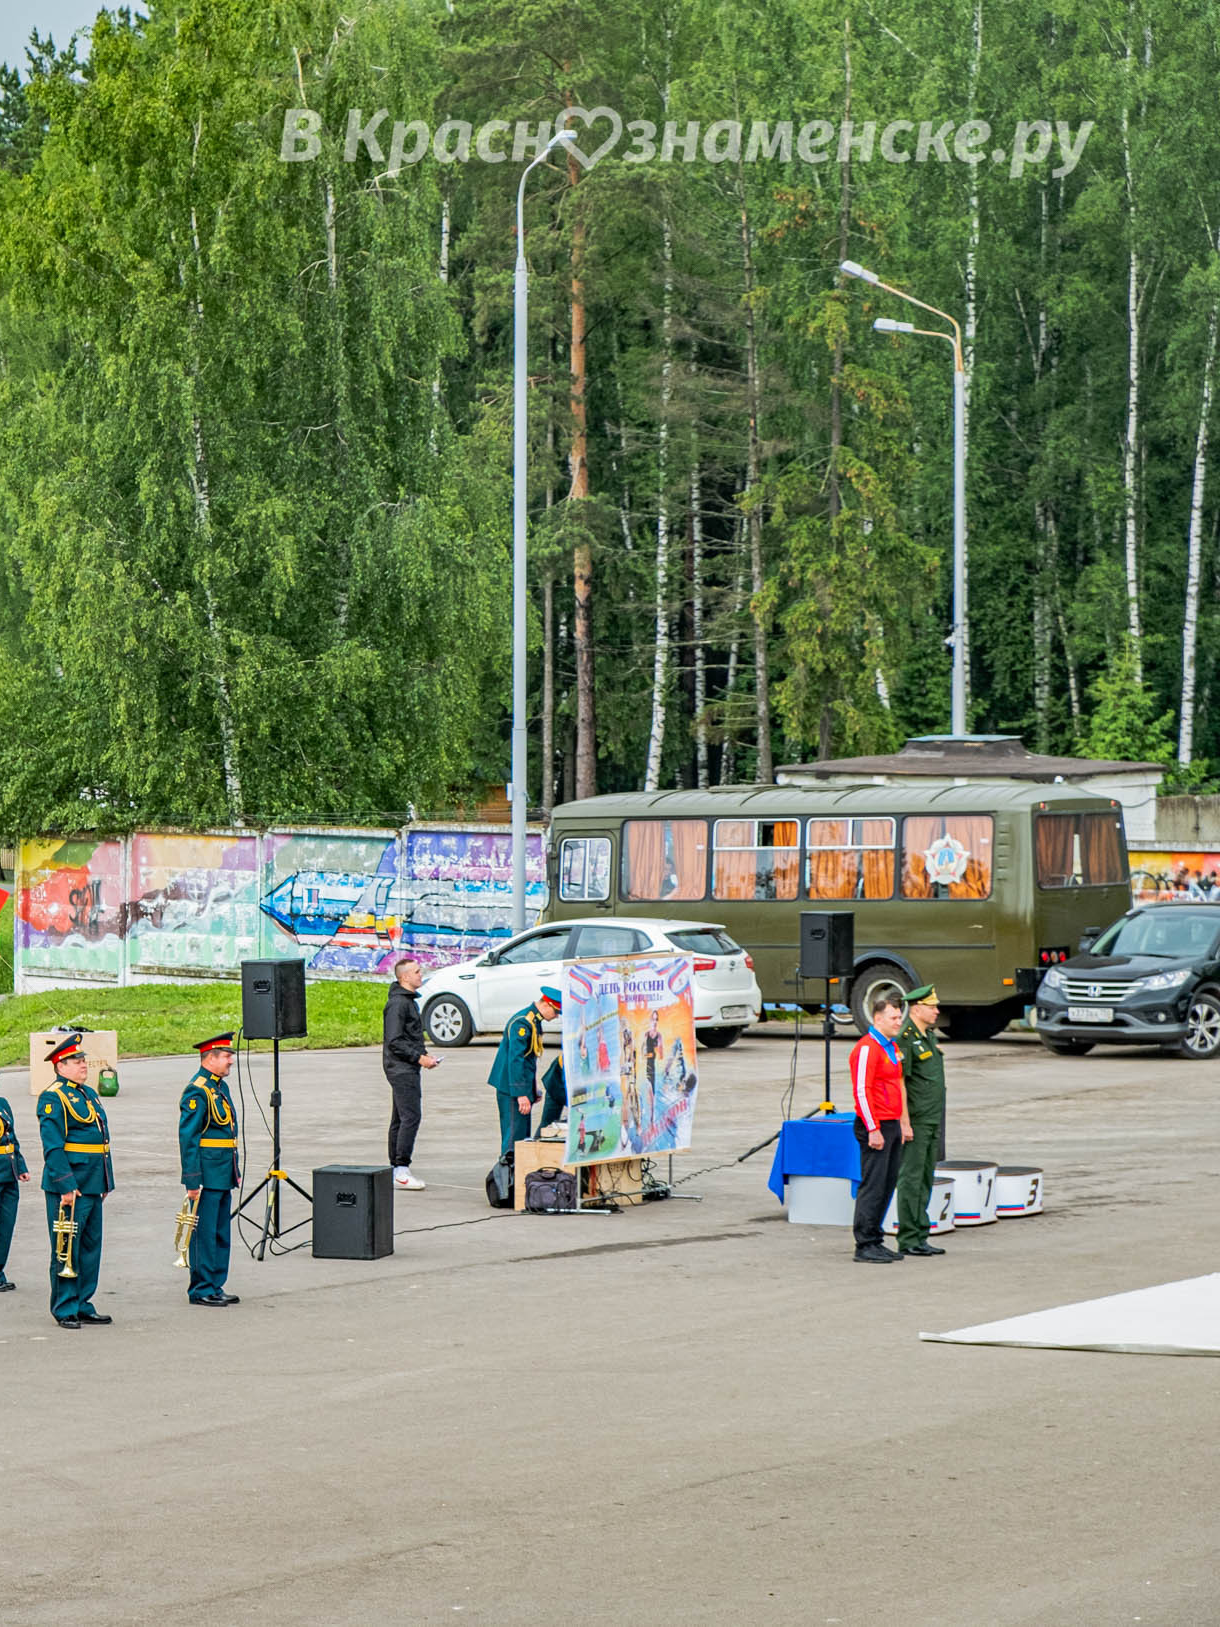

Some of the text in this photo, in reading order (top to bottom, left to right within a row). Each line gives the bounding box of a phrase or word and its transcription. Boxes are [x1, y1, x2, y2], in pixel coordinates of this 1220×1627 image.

[598, 979, 664, 995] ДЕНЬ РОССИИ
[985, 1179, 993, 1207] 1
[1027, 1178, 1039, 1206] 3
[940, 1192, 951, 1221] 2
